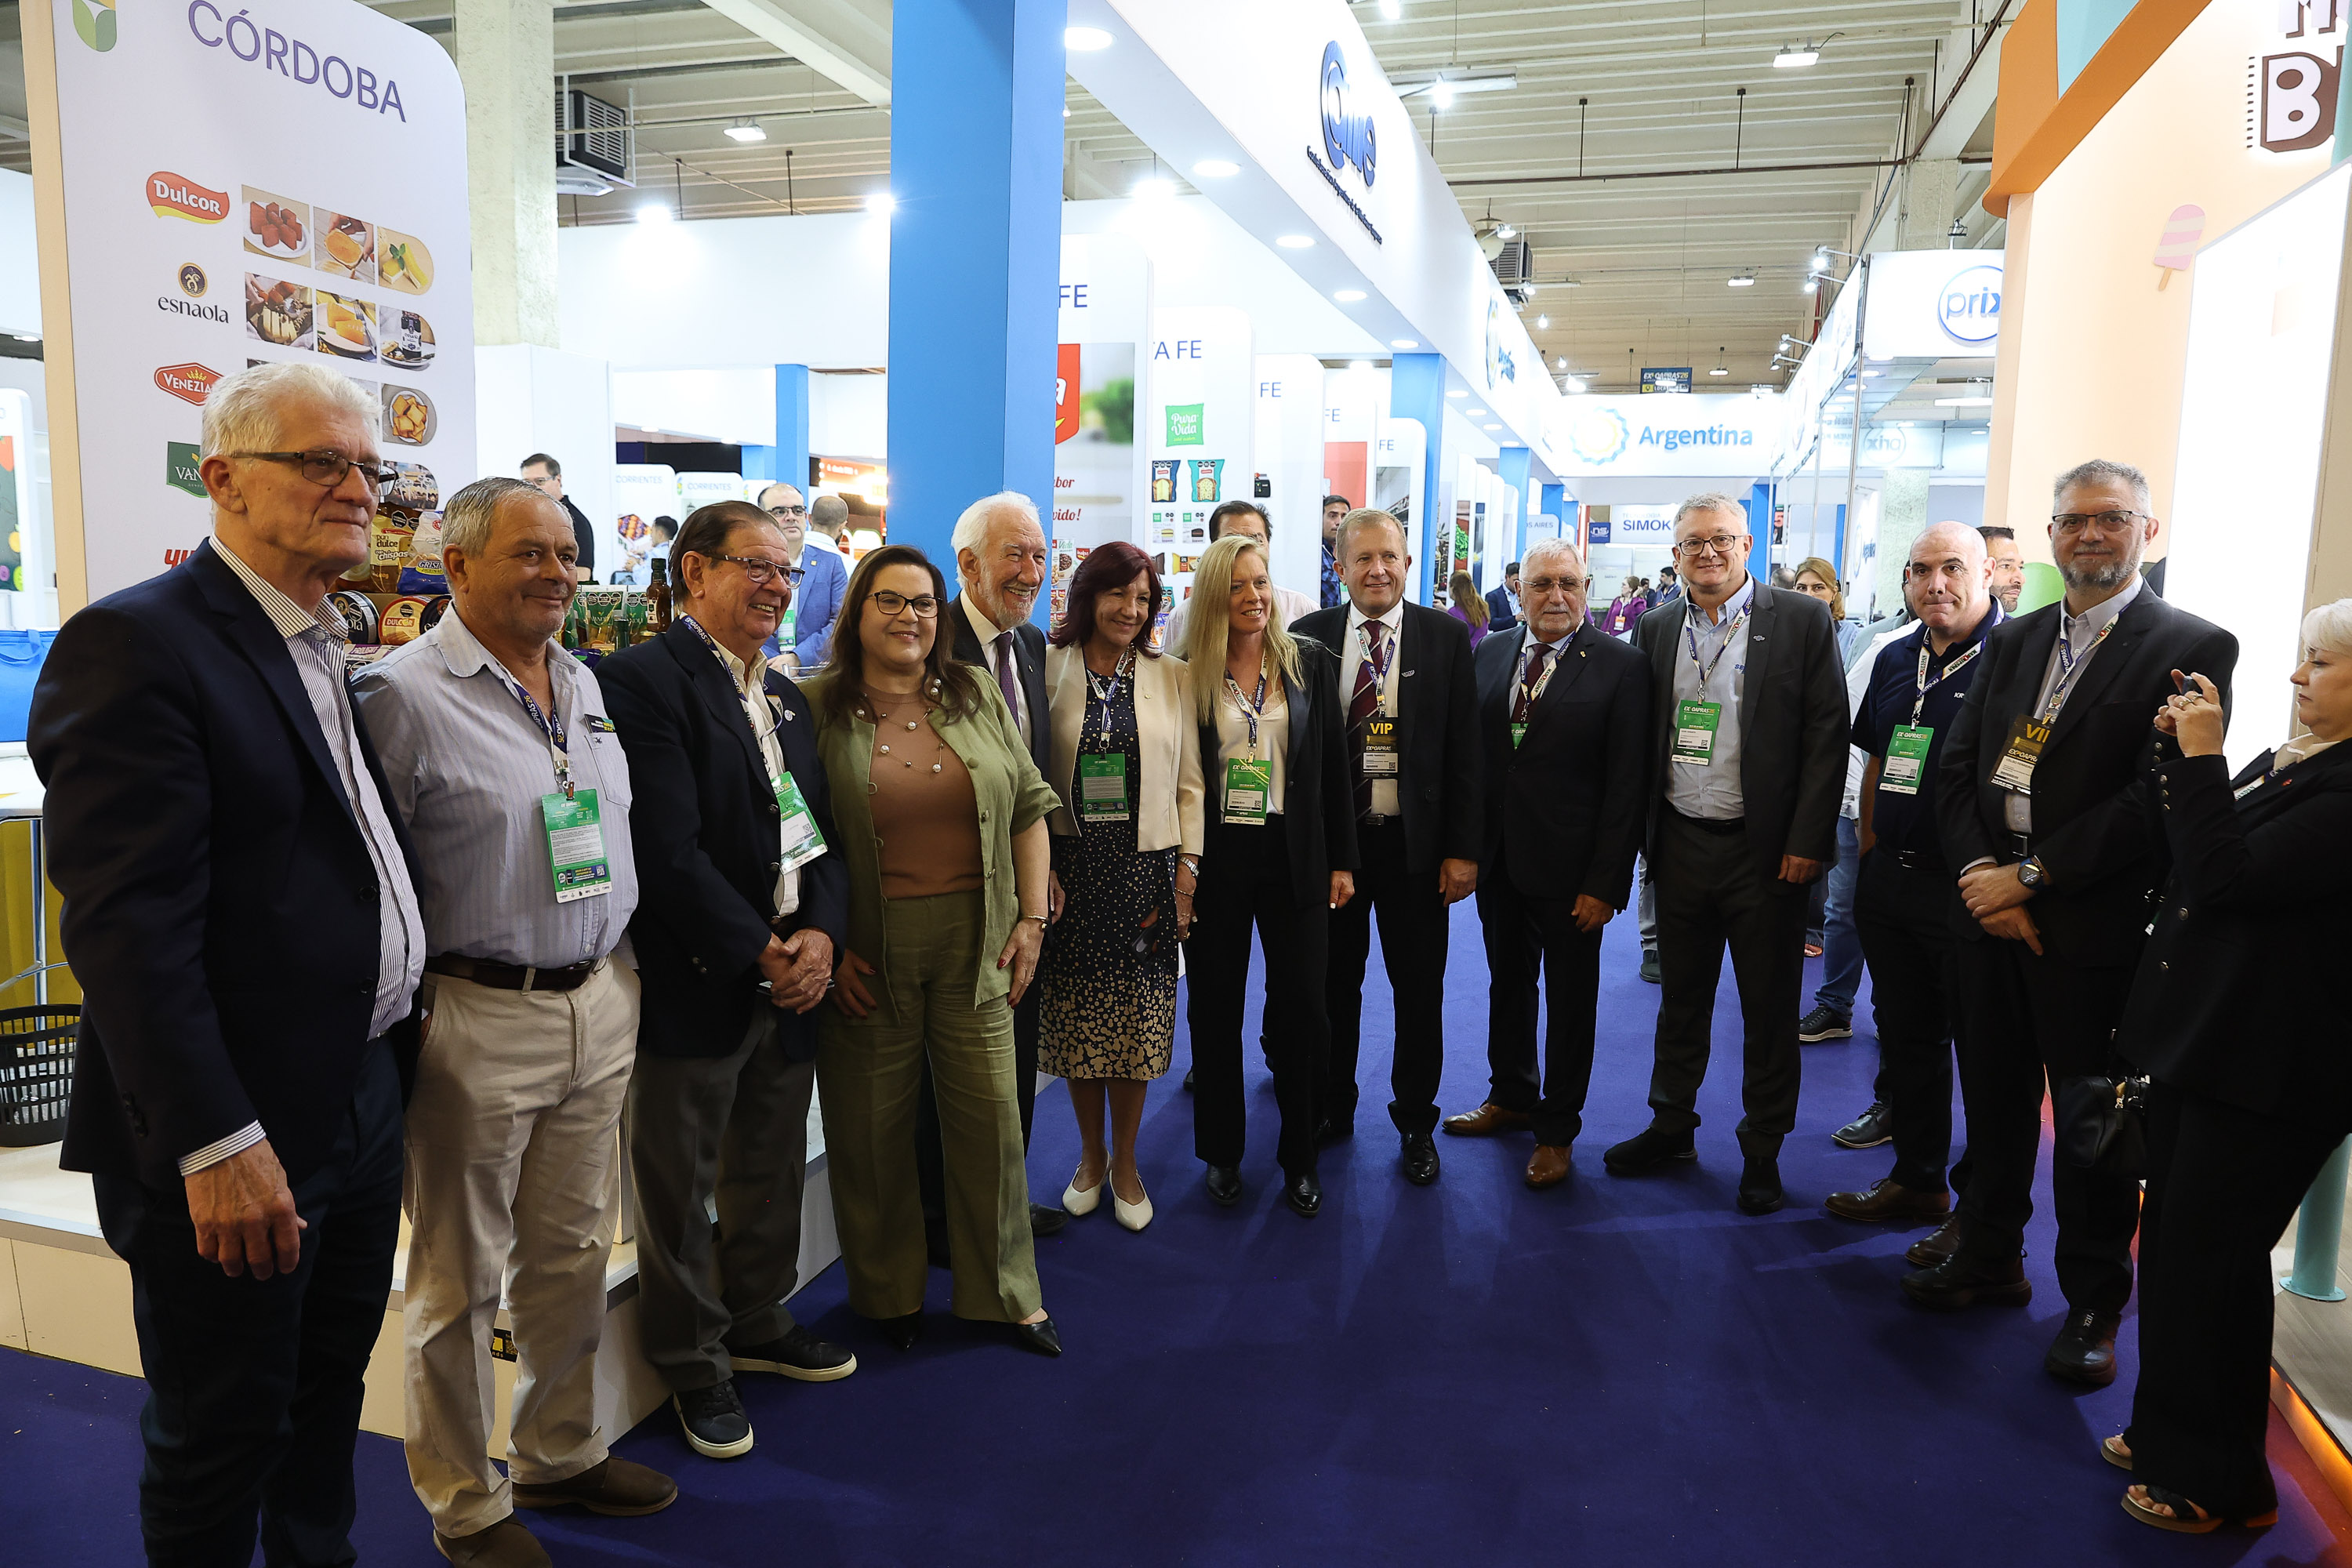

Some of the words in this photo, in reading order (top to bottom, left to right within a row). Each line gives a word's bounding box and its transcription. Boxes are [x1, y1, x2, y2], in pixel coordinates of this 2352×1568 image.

[188, 0, 406, 123] CÓRDOBA
[158, 296, 229, 323] esnaola
[1178, 340, 1202, 359] FE
[1260, 382, 1281, 397] FE
[1171, 413, 1199, 425] Pura
[1171, 424, 1197, 435] Vida
[1639, 424, 1752, 450] Argentina
[1379, 439, 1395, 451] FE
[175, 466, 203, 481] VAN
[688, 481, 731, 491] CORRIENTES
[1623, 520, 1671, 531] SIMOK
[378, 550, 408, 561] chispas
[1370, 722, 1393, 735] VIP
